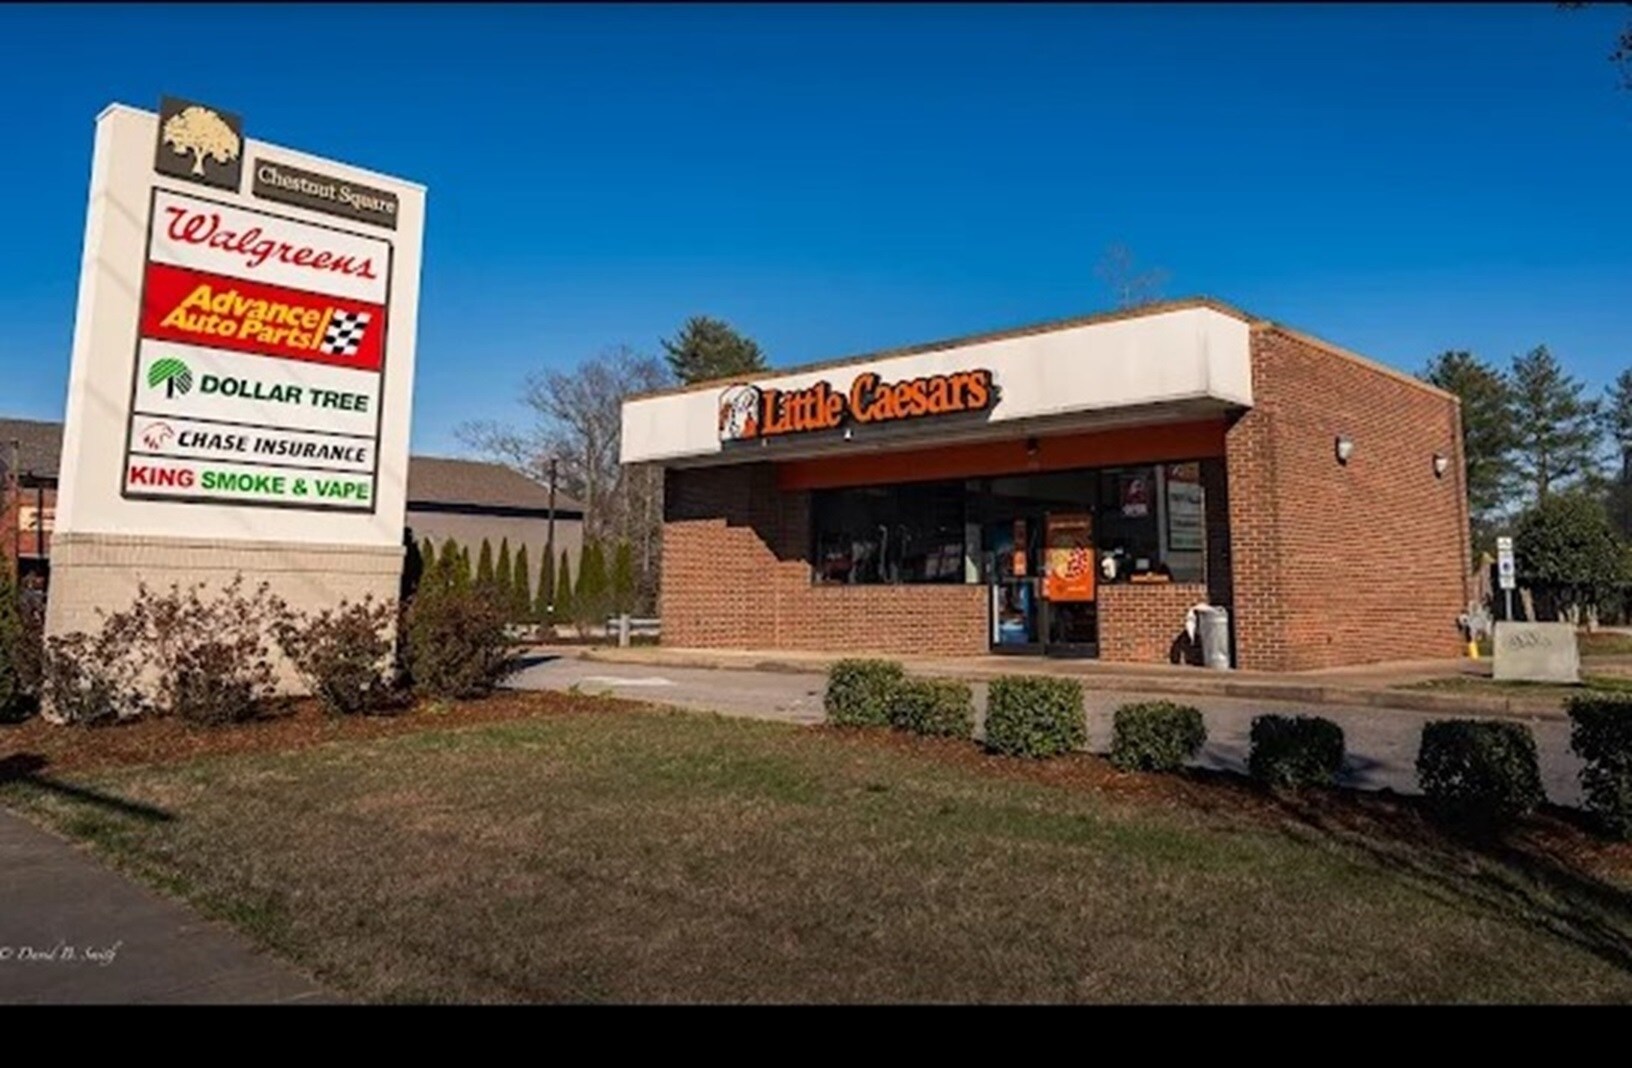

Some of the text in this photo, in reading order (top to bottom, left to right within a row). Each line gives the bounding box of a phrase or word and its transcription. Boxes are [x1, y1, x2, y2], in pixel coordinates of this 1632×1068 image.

[257, 164, 398, 216] Chestnut Square
[165, 205, 378, 281] Walgreens
[159, 304, 312, 348] Auto Parts
[180, 284, 321, 328] Advance
[200, 374, 371, 413] DOLLAR TREE
[760, 368, 992, 435] Little Caesars
[177, 430, 367, 464] CHASE INSURANCE
[129, 465, 369, 501] KING SMOKE & VAPE
